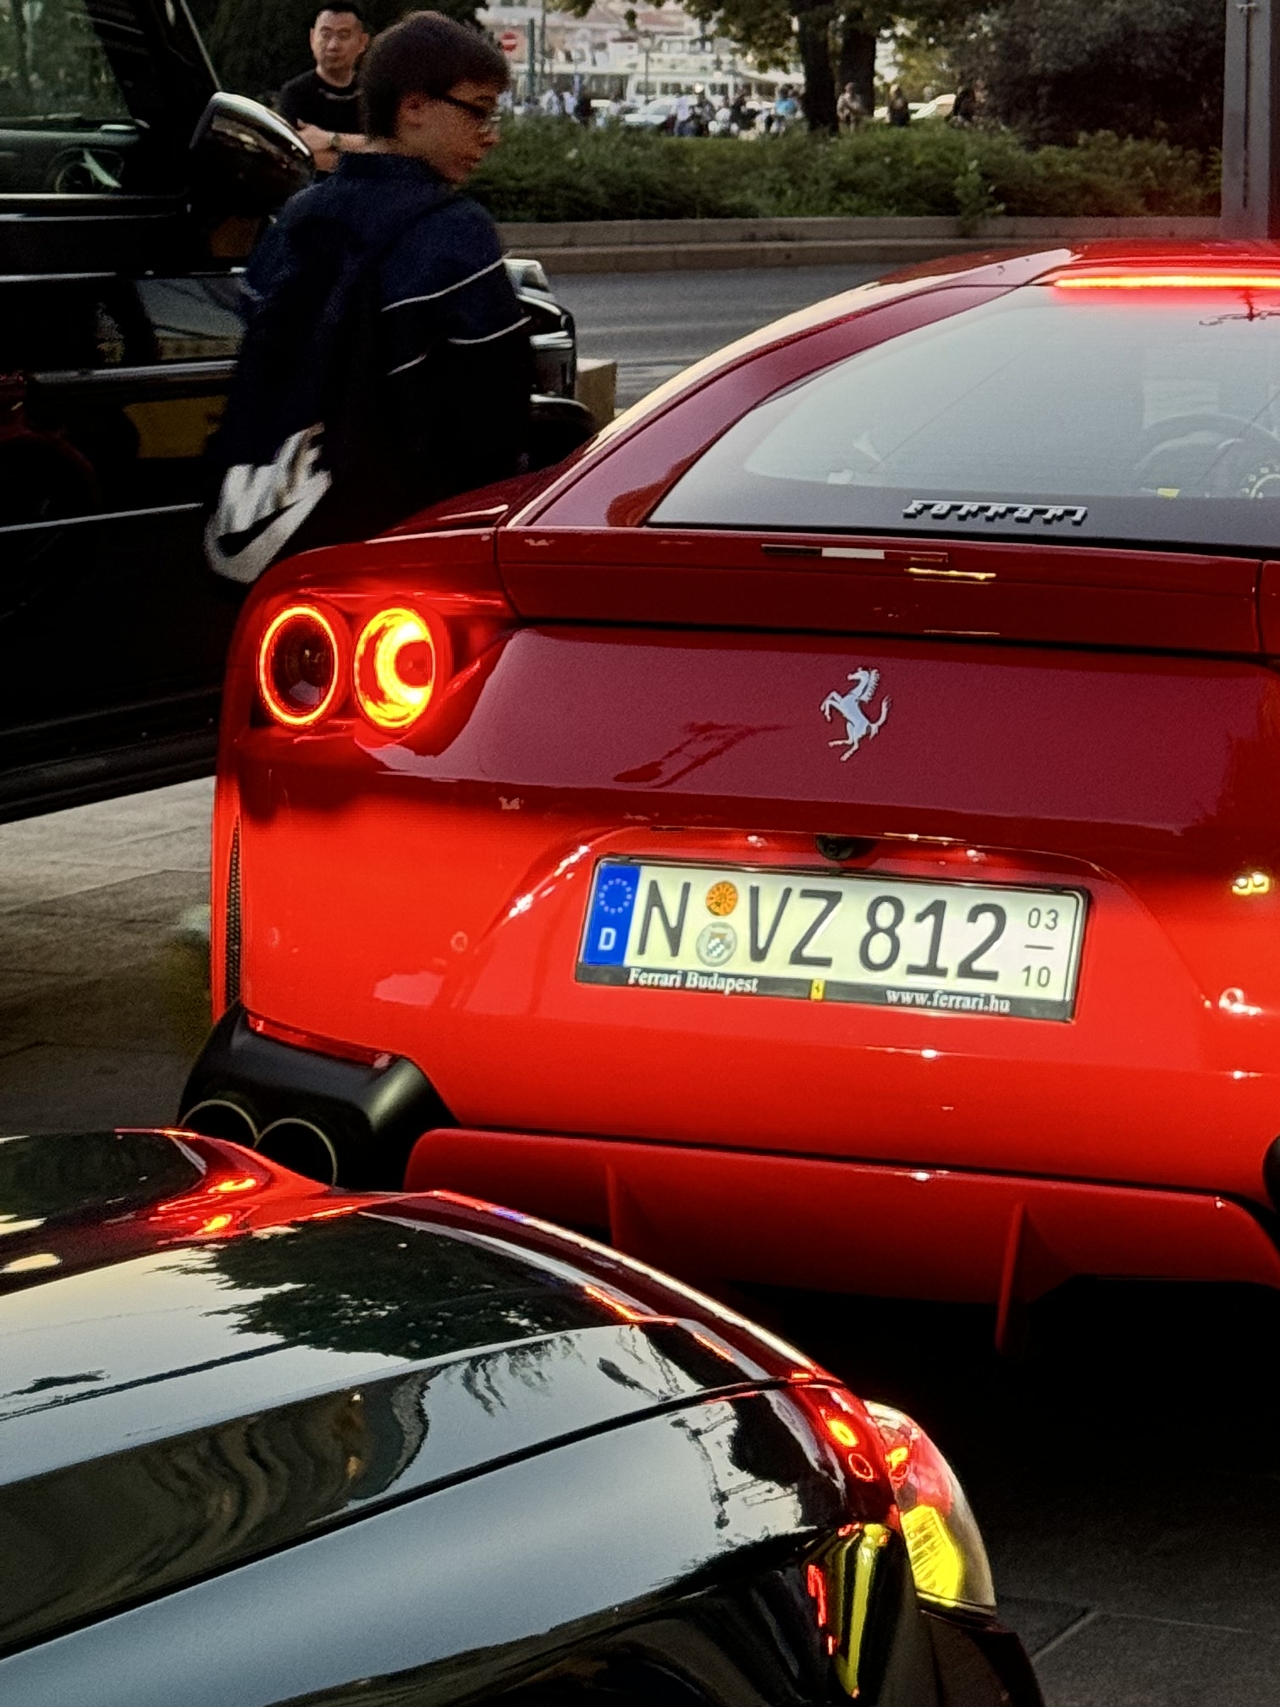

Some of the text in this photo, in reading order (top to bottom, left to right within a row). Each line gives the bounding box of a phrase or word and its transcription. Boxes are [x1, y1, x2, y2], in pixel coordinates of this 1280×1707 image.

[902, 499, 1088, 524] Ferrari
[637, 879, 1007, 982] N VZ 812
[1027, 907, 1059, 931] 03
[598, 927, 617, 951] D
[627, 967, 759, 996] Ferrari Budapest
[1021, 965, 1052, 988] 10
[885, 987, 1011, 1014] www.ferrari.hu
